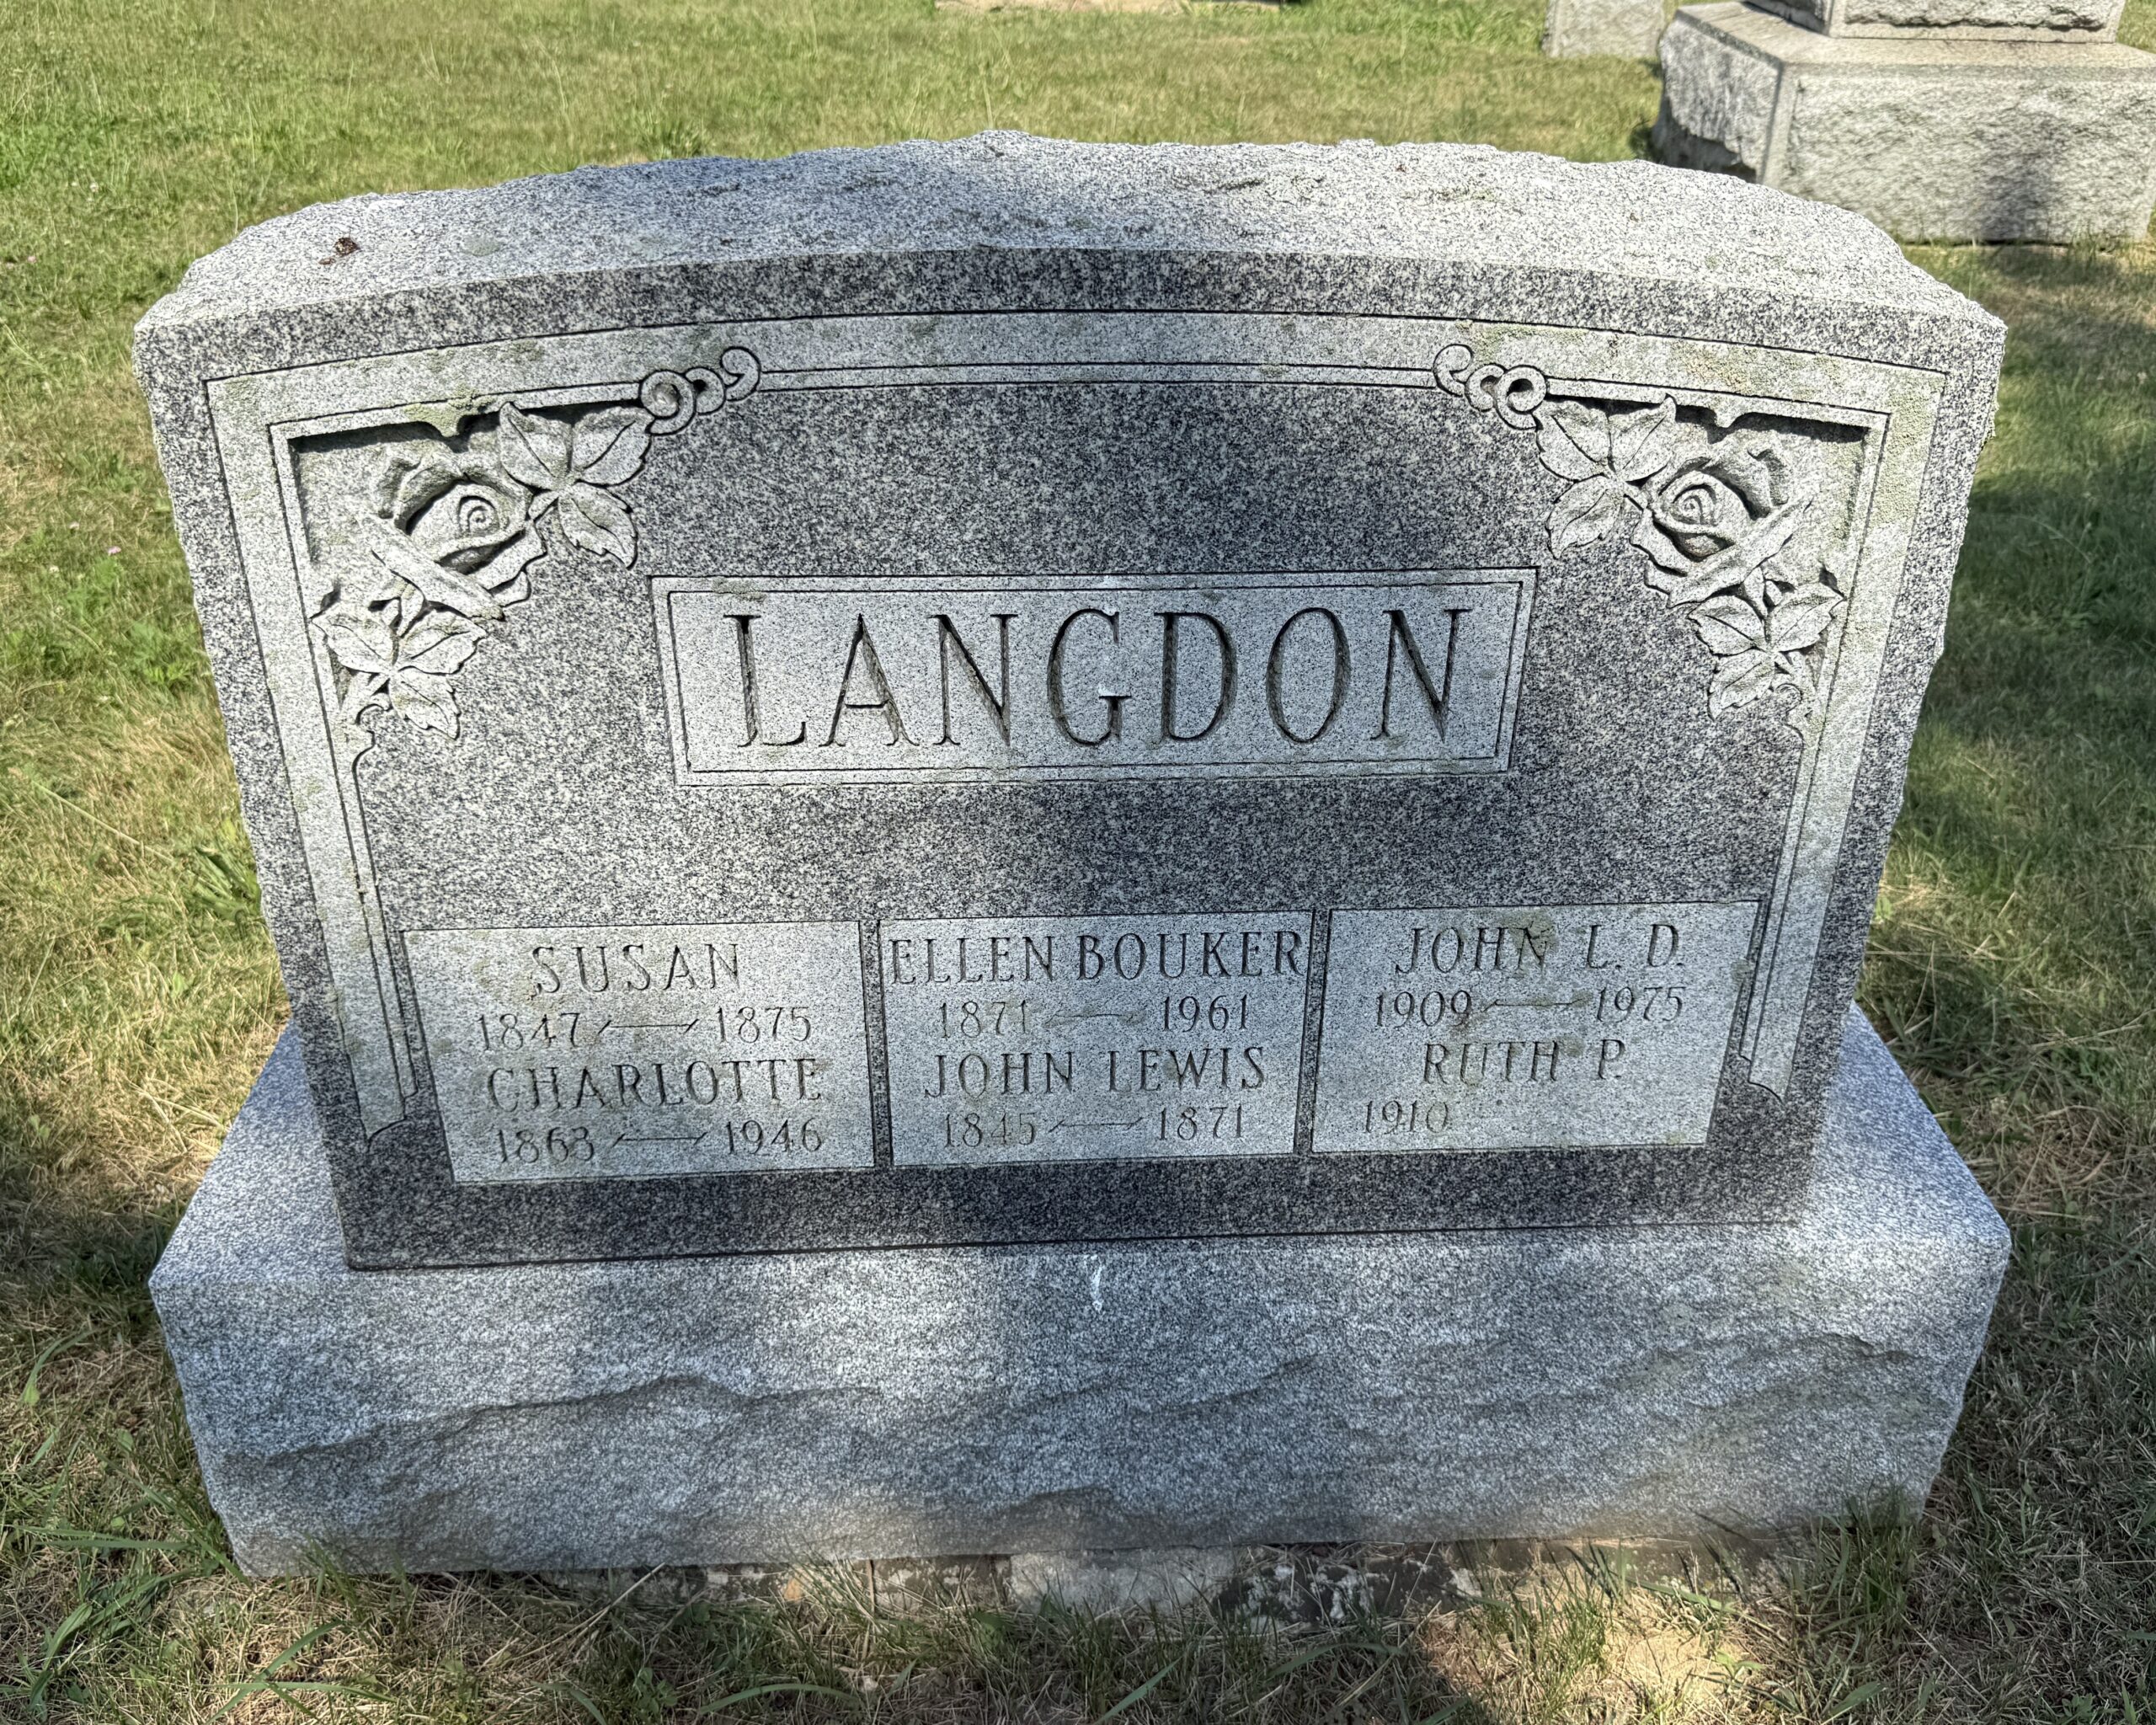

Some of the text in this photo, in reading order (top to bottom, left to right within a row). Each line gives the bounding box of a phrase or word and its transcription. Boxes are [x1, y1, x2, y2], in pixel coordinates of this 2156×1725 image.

[723, 605, 1472, 748] LANGDON
[530, 943, 740, 996] SUSAN
[891, 931, 1306, 985] ELLEN BOUKER
[1395, 923, 1685, 974] JOHN L. D.
[476, 1006, 812, 1051] 1847 1875
[939, 995, 1250, 1038] 1871 1961
[1375, 986, 1687, 1028] 1909 1975
[486, 1058, 821, 1112] CHARLOTTE
[926, 1046, 1266, 1097] JOHN LEWIS
[1422, 1040, 1562, 1085] RUTH
[725, 1119, 823, 1155] 1946
[943, 1104, 1245, 1148] 1845 1871
[1362, 1100, 1452, 1135] 1910
